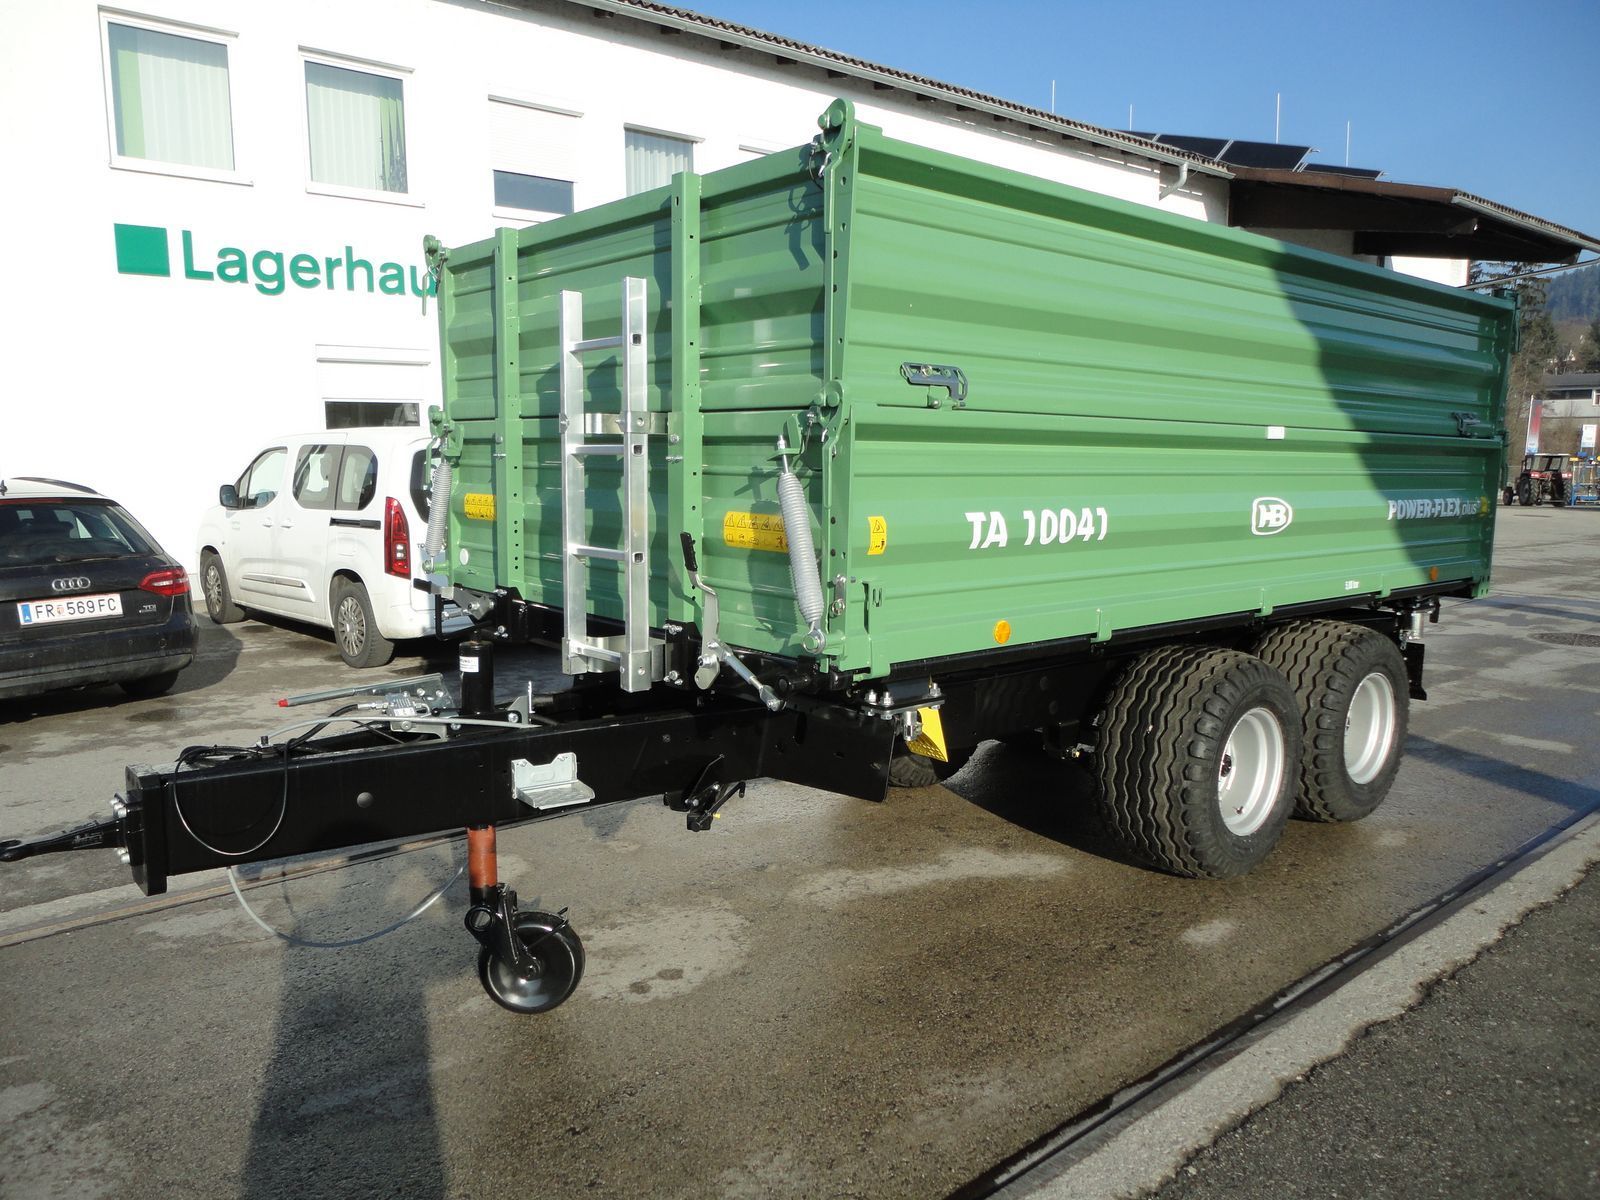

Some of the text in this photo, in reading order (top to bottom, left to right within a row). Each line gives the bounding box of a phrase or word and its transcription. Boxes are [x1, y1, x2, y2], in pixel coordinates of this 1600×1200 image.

[1387, 498, 1460, 520] POWER-FLEX
[964, 507, 1108, 549] TA 10041
[35, 604, 55, 619] FR
